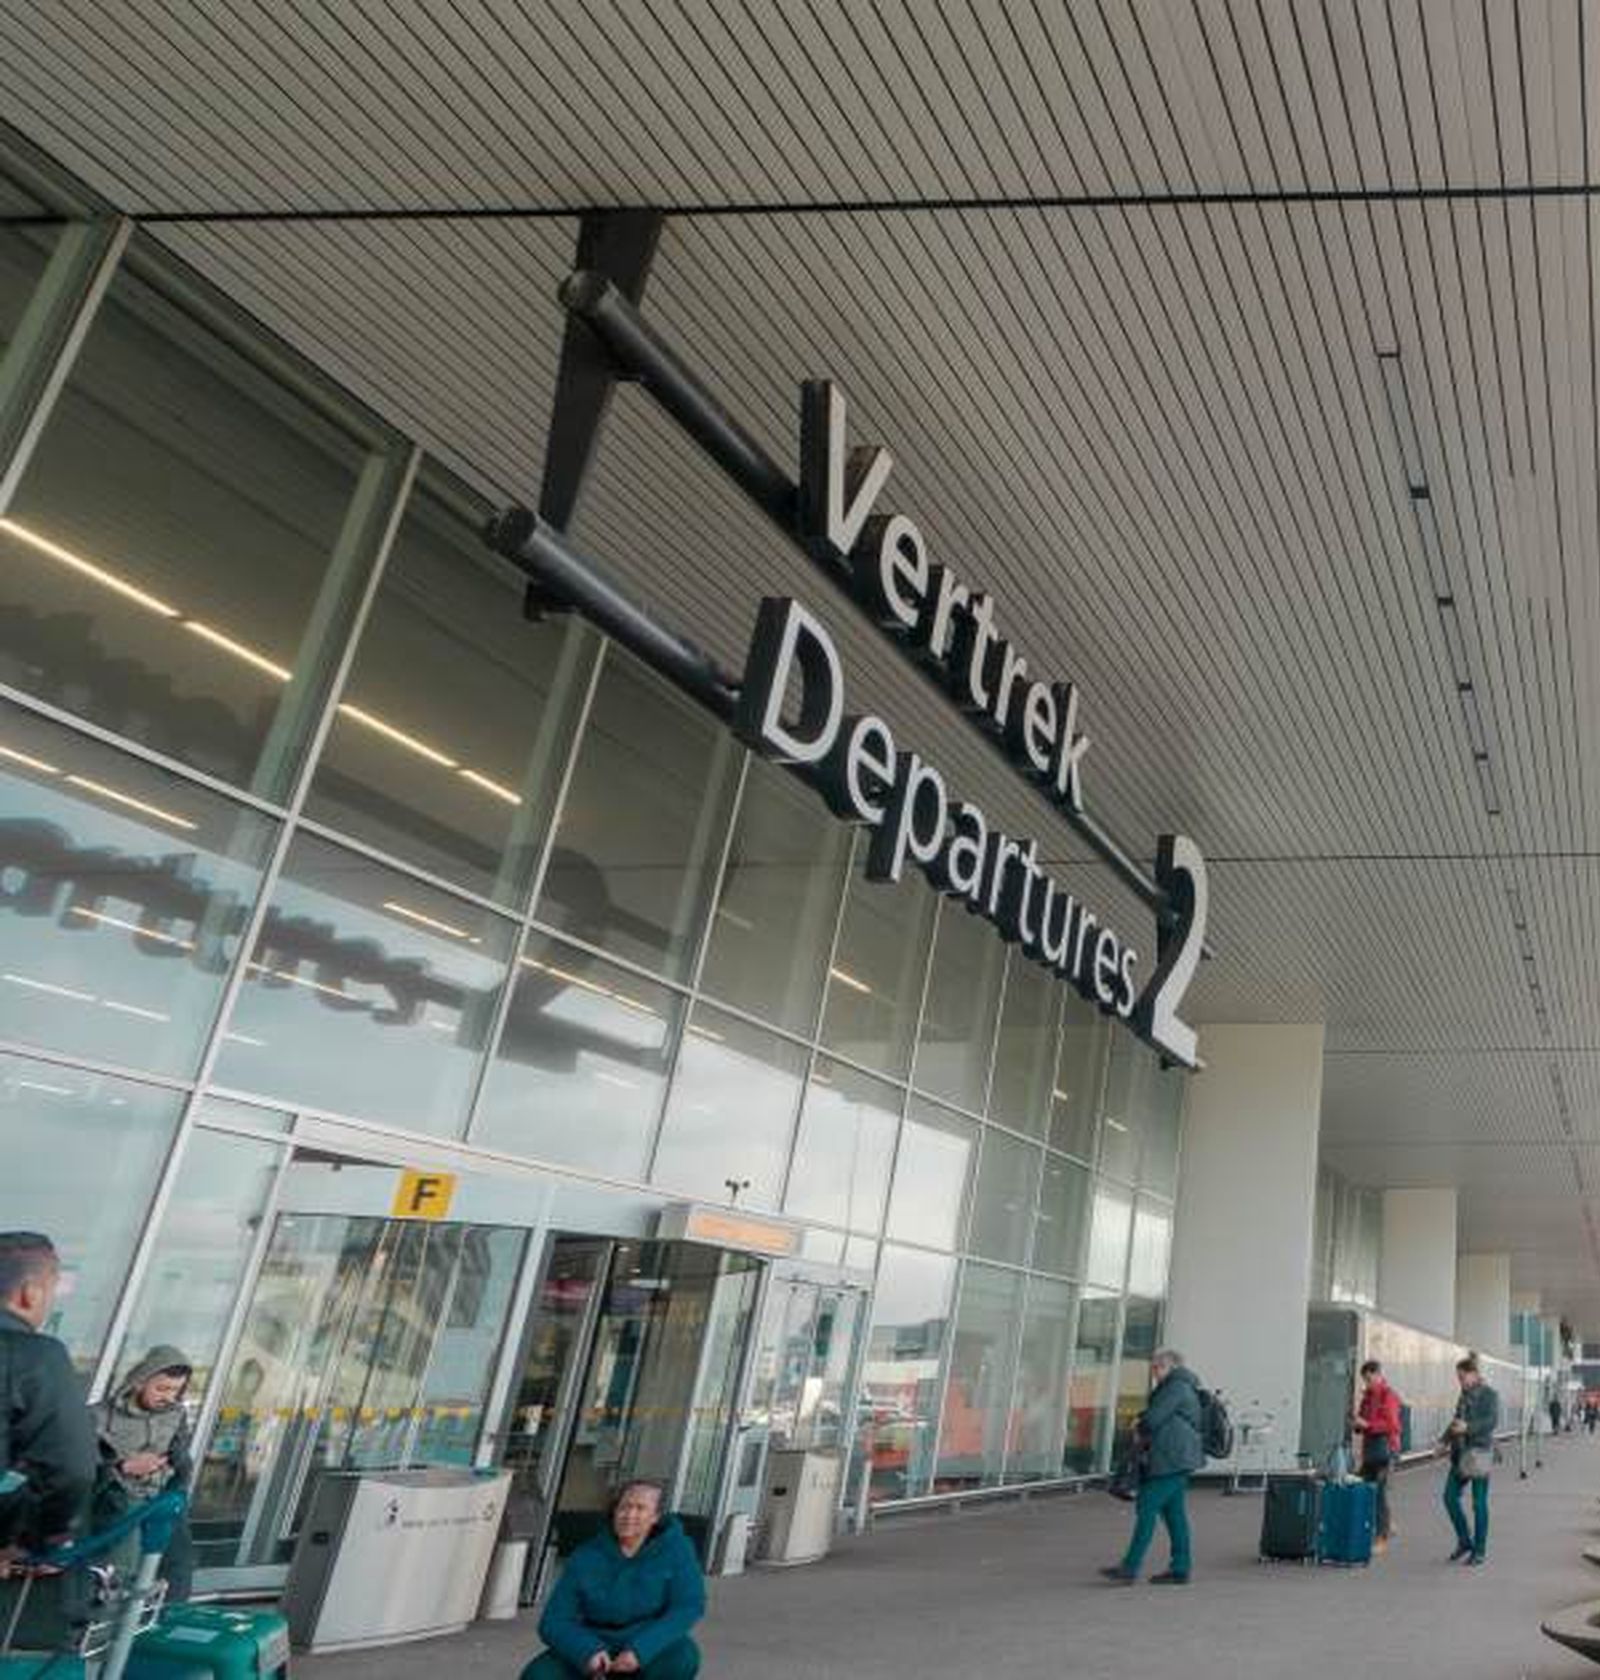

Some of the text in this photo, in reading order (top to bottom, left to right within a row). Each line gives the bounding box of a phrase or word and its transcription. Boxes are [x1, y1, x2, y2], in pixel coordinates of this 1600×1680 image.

[822, 379, 1092, 810] Vertrek
[759, 599, 1139, 1019] Departures
[1148, 835, 1208, 1067] 2
[411, 1178, 442, 1212] F
